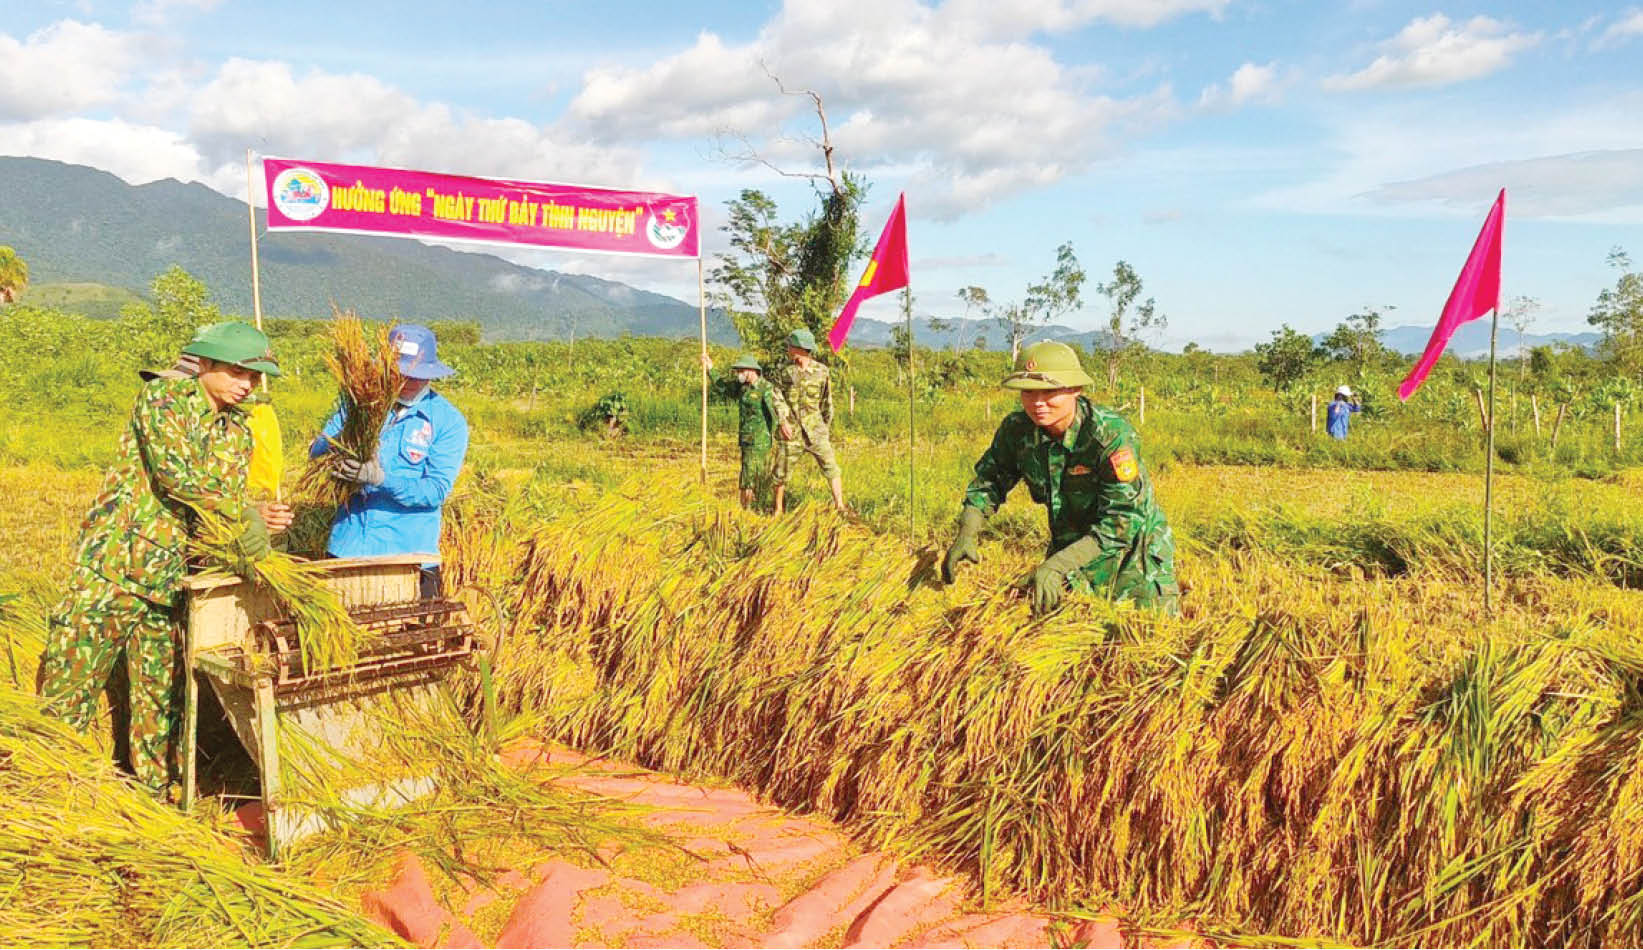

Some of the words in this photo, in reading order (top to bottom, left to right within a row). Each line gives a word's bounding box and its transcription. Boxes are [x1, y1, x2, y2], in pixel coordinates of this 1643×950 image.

[332, 180, 385, 213] HƯỞNG
[389, 186, 421, 216] ỨNG
[478, 194, 507, 224] THỨ
